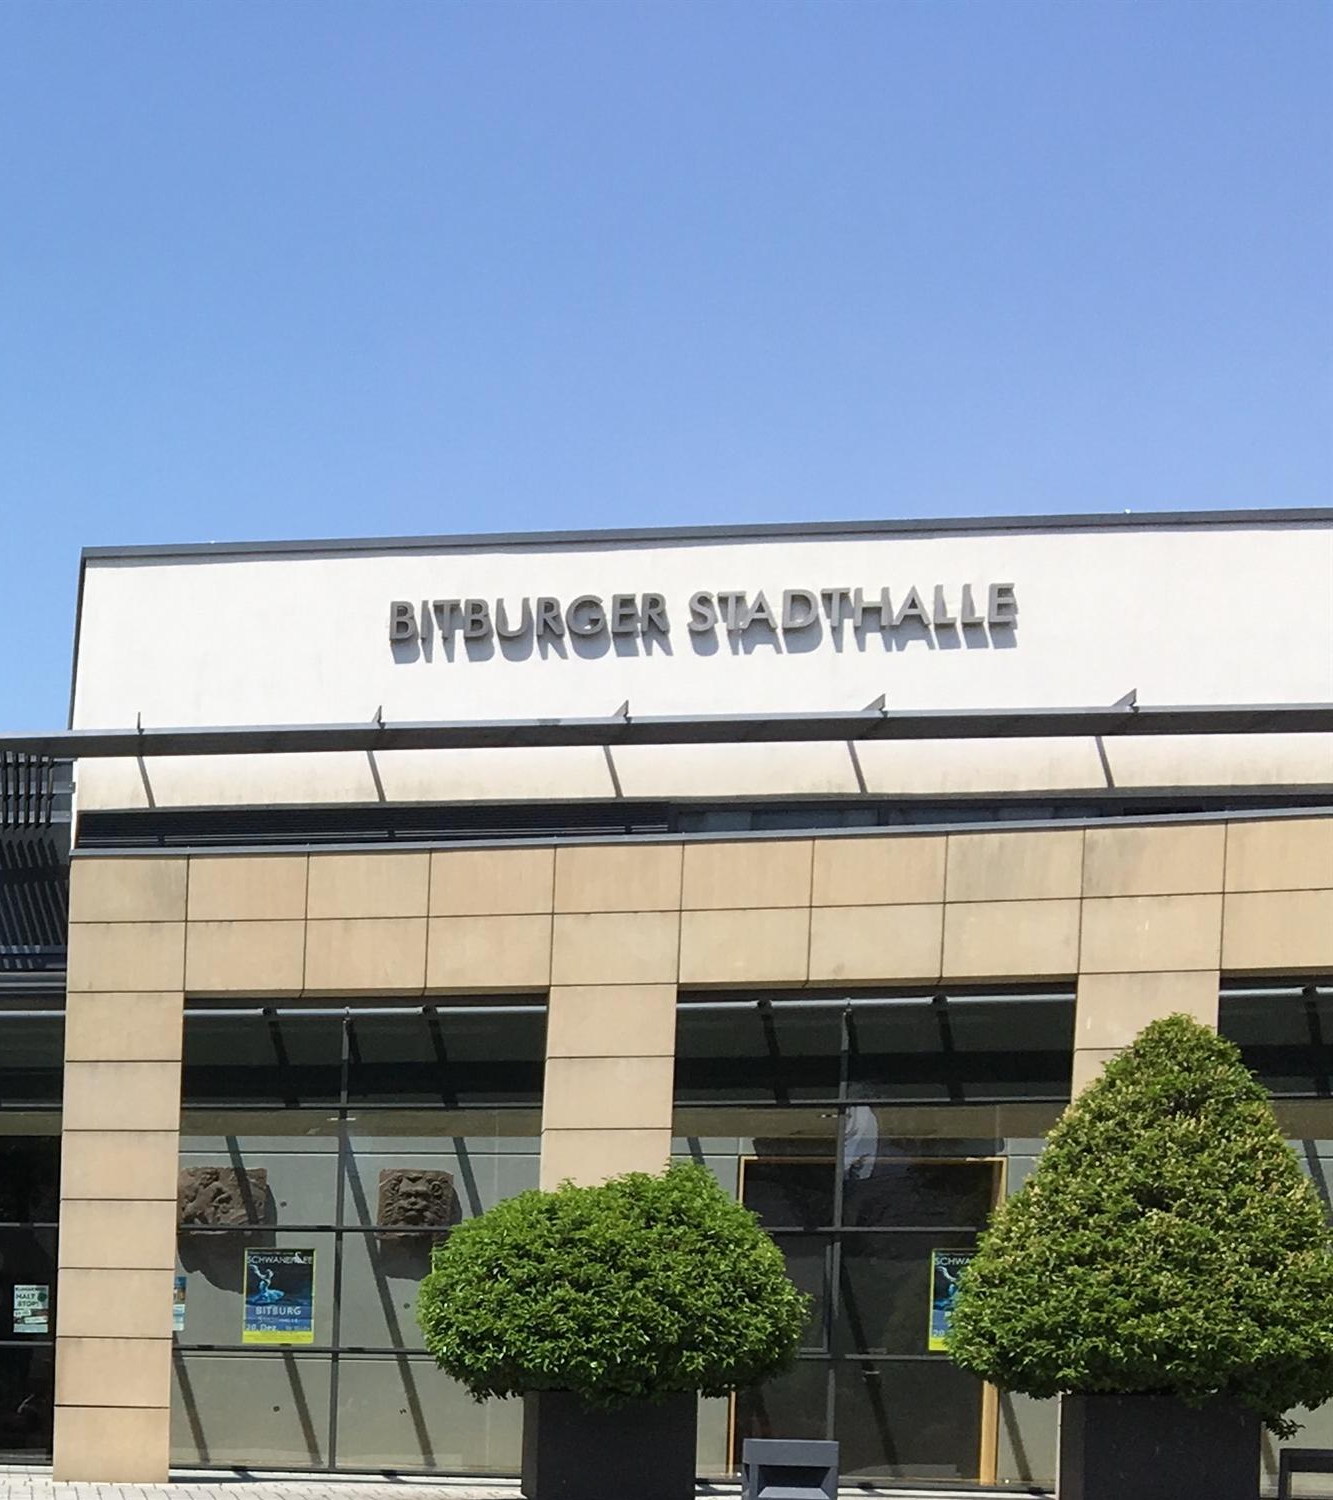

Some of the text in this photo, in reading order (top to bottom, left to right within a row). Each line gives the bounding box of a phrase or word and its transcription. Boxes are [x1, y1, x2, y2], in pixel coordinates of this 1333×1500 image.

[389, 583, 1017, 641] BITBURGER STADTHALLE
[255, 1306, 302, 1316] BITBURG
